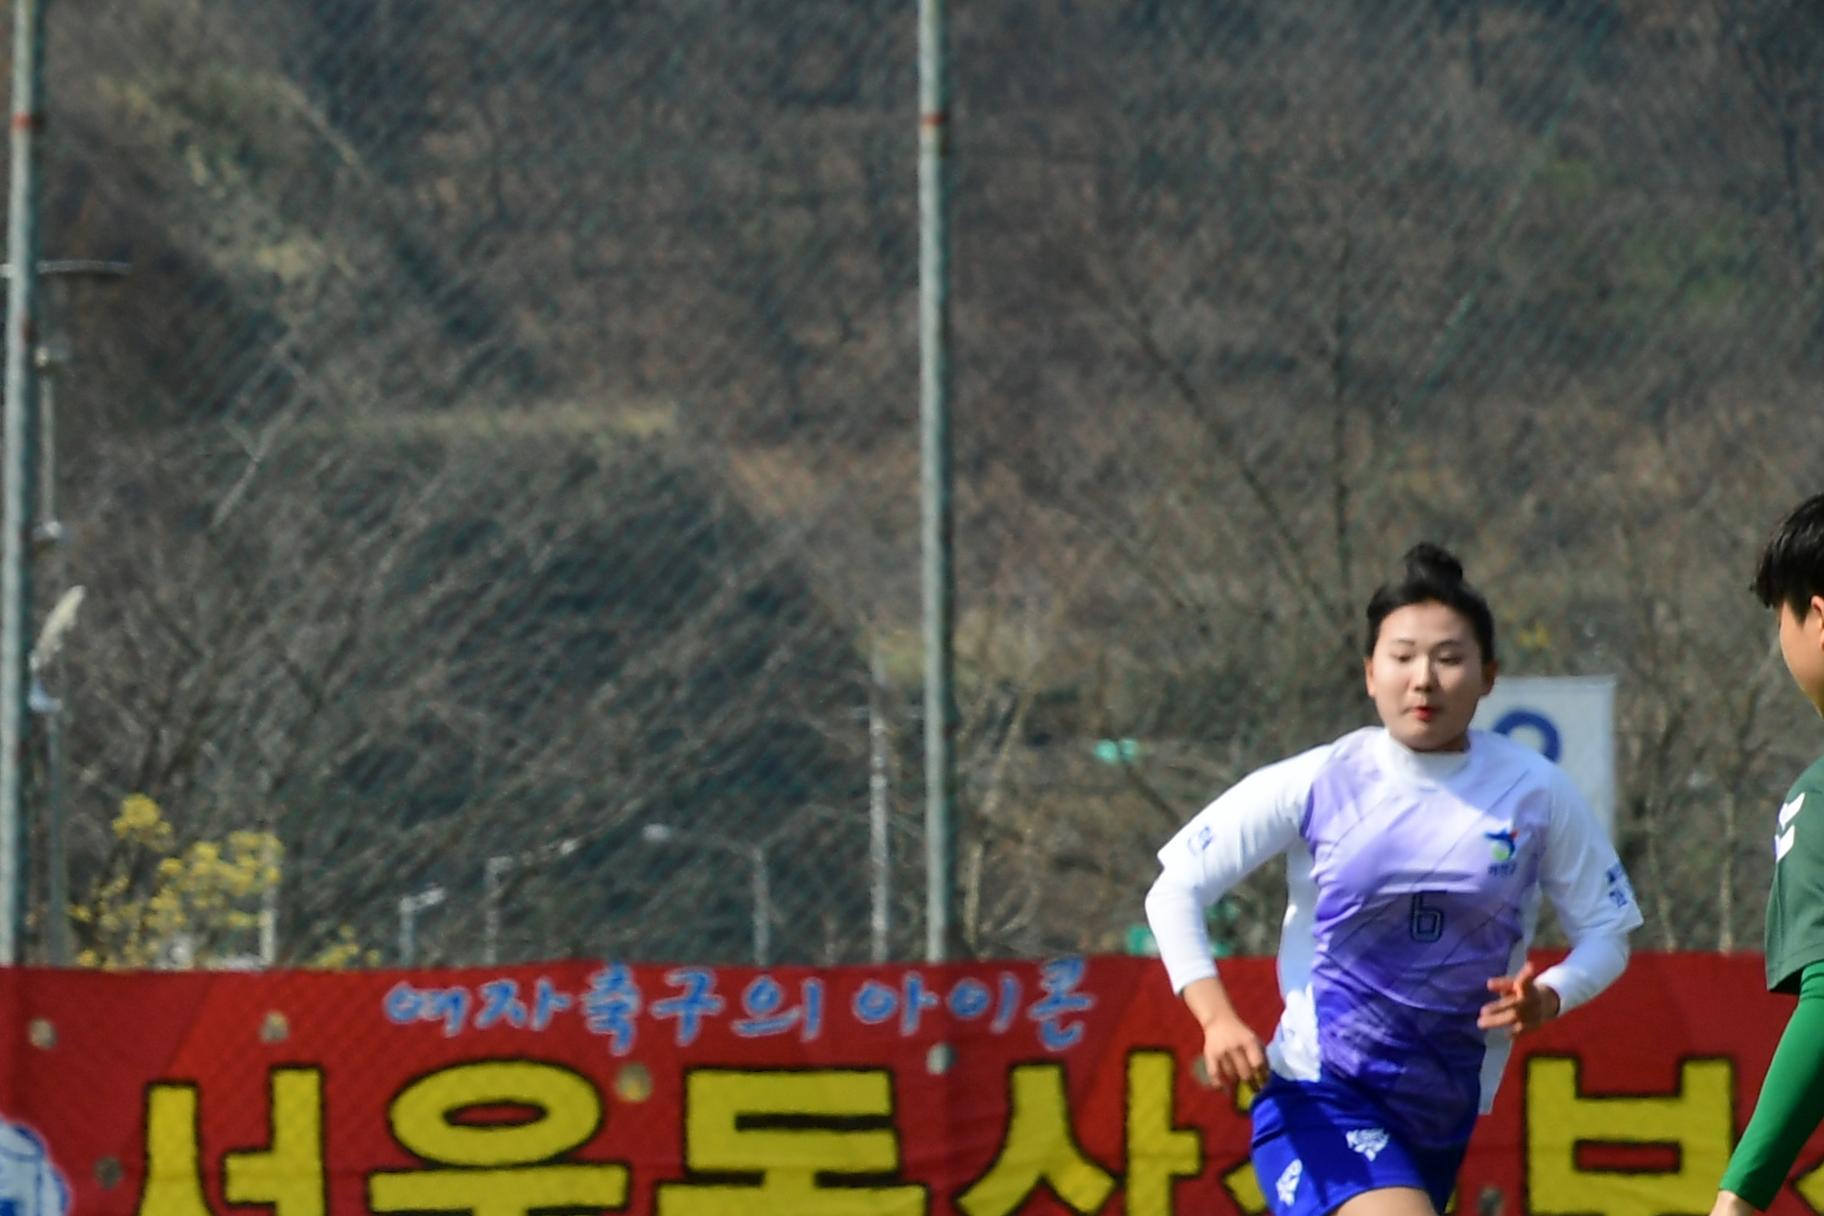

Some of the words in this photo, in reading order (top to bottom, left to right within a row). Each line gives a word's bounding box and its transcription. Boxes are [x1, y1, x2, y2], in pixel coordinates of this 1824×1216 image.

[1410, 889, 1444, 943] 6
[382, 960, 824, 1056] 여자축구의
[850, 954, 1093, 1051] 아이콘
